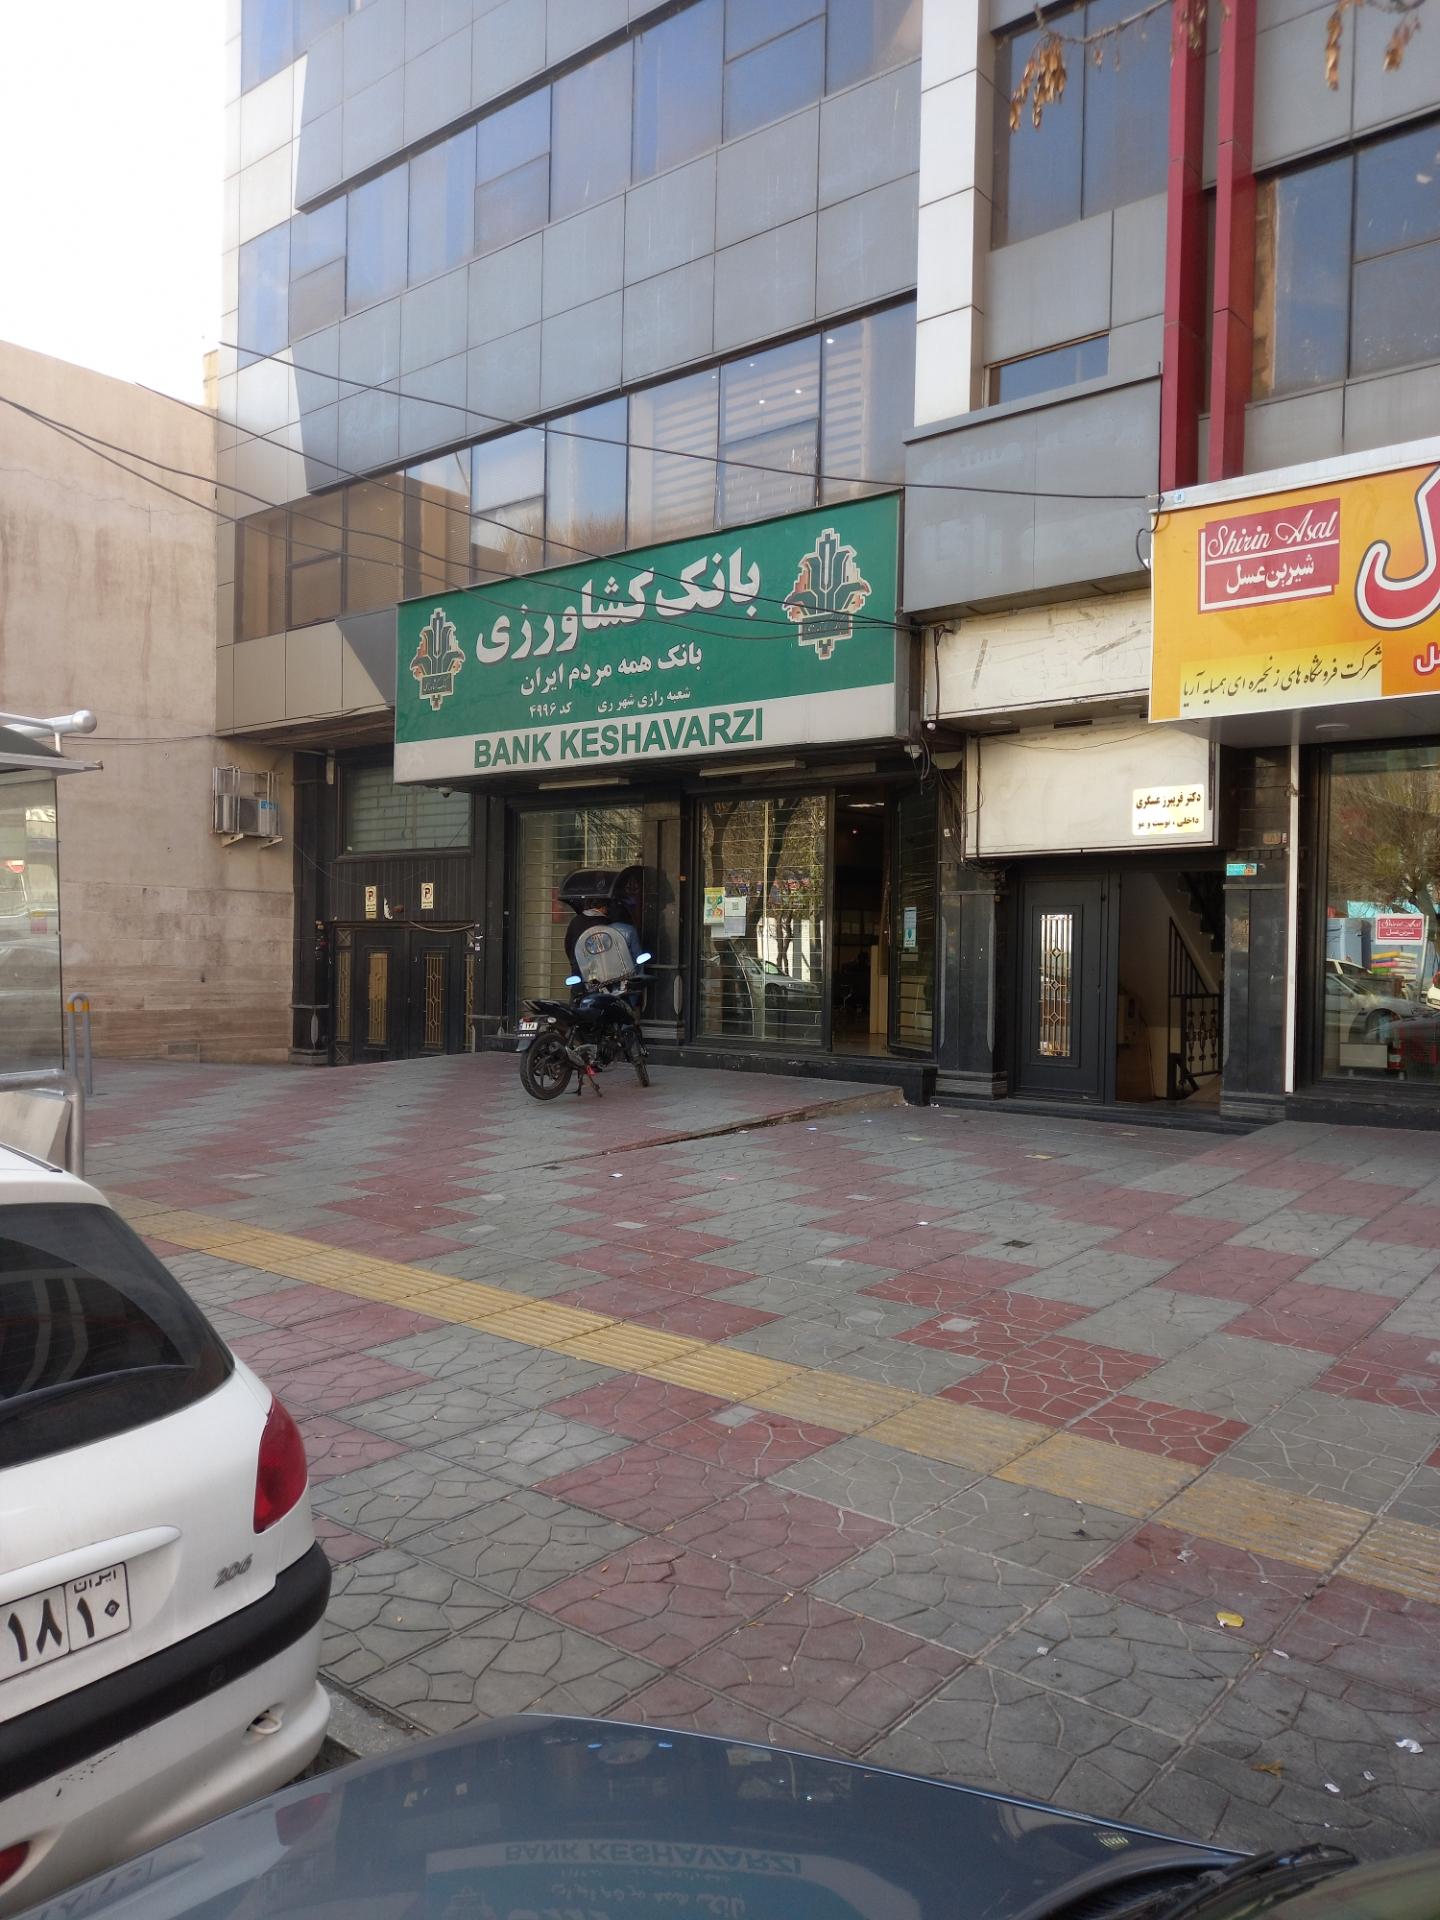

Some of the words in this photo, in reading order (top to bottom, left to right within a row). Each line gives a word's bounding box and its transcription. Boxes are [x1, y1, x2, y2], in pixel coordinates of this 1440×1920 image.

[1207, 525, 1272, 557] Shirin
[1275, 509, 1338, 544] Asal
[656, 547, 760, 617] بانک
[1226, 563, 1266, 594] عسل
[1265, 554, 1315, 588] شیرین
[476, 566, 655, 663] کشاورزی
[617, 655, 652, 675] همه
[657, 641, 703, 671] بانک
[1303, 654, 1338, 686] فروشگاه
[1340, 640, 1384, 681] شرکت
[520, 662, 564, 696] ایران
[568, 663, 613, 690] مردم
[1183, 670, 1206, 708] آریا
[559, 701, 573, 715] کد
[597, 702, 614, 713] ری
[616, 693, 635, 712] شهر
[637, 690, 664, 709] رازی
[666, 686, 691, 704] شعبه
[474, 732, 551, 769] BANK
[560, 707, 764, 760] KESHAVARZI
[73, 1568, 117, 1594] ایران
